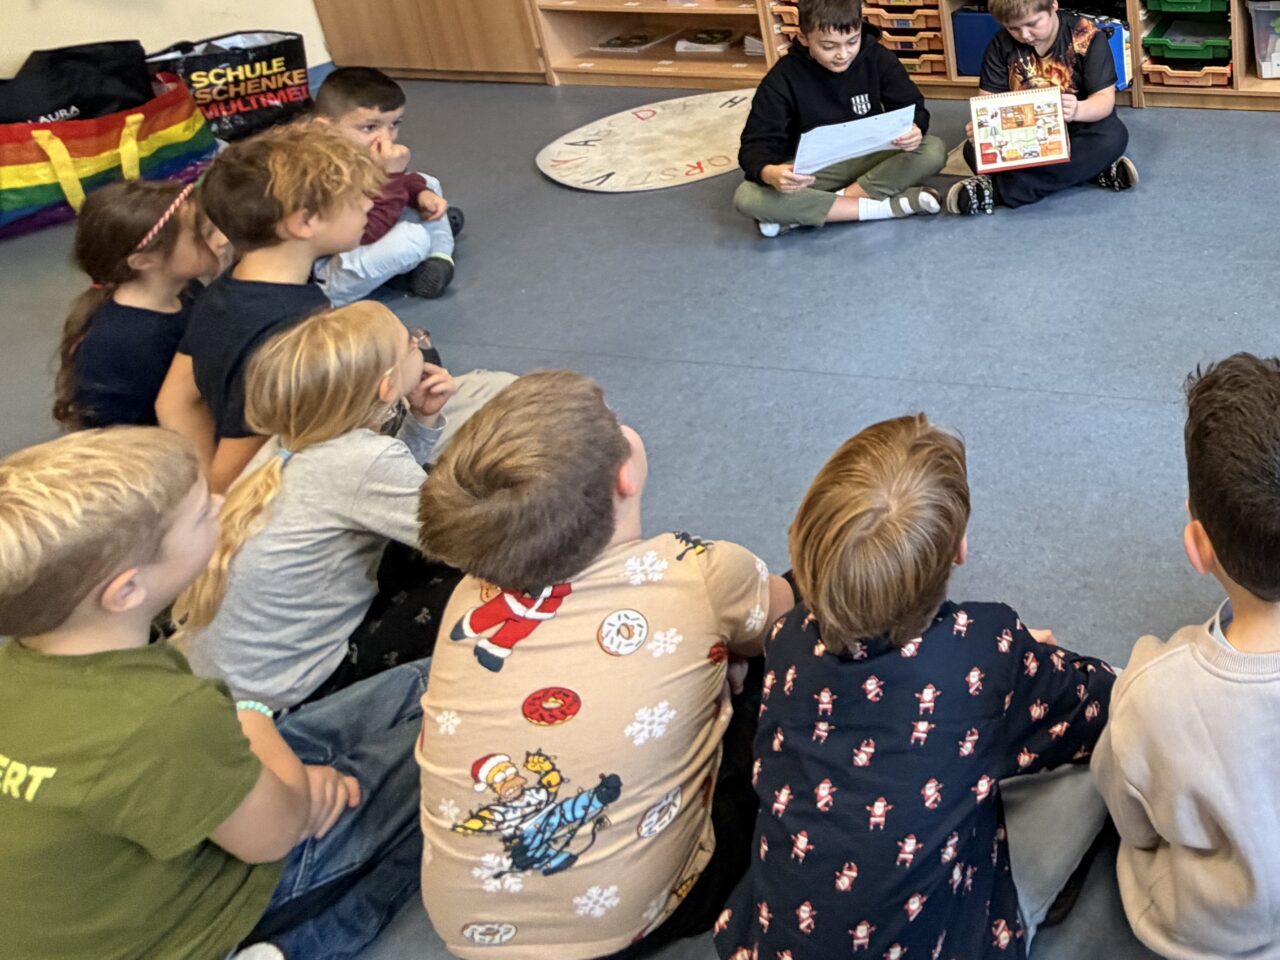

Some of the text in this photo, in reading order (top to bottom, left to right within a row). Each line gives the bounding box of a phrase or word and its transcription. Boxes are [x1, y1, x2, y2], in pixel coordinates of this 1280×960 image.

[190, 57, 287, 89] SCHULE
[632, 108, 657, 121] D
[684, 161, 706, 177] R
